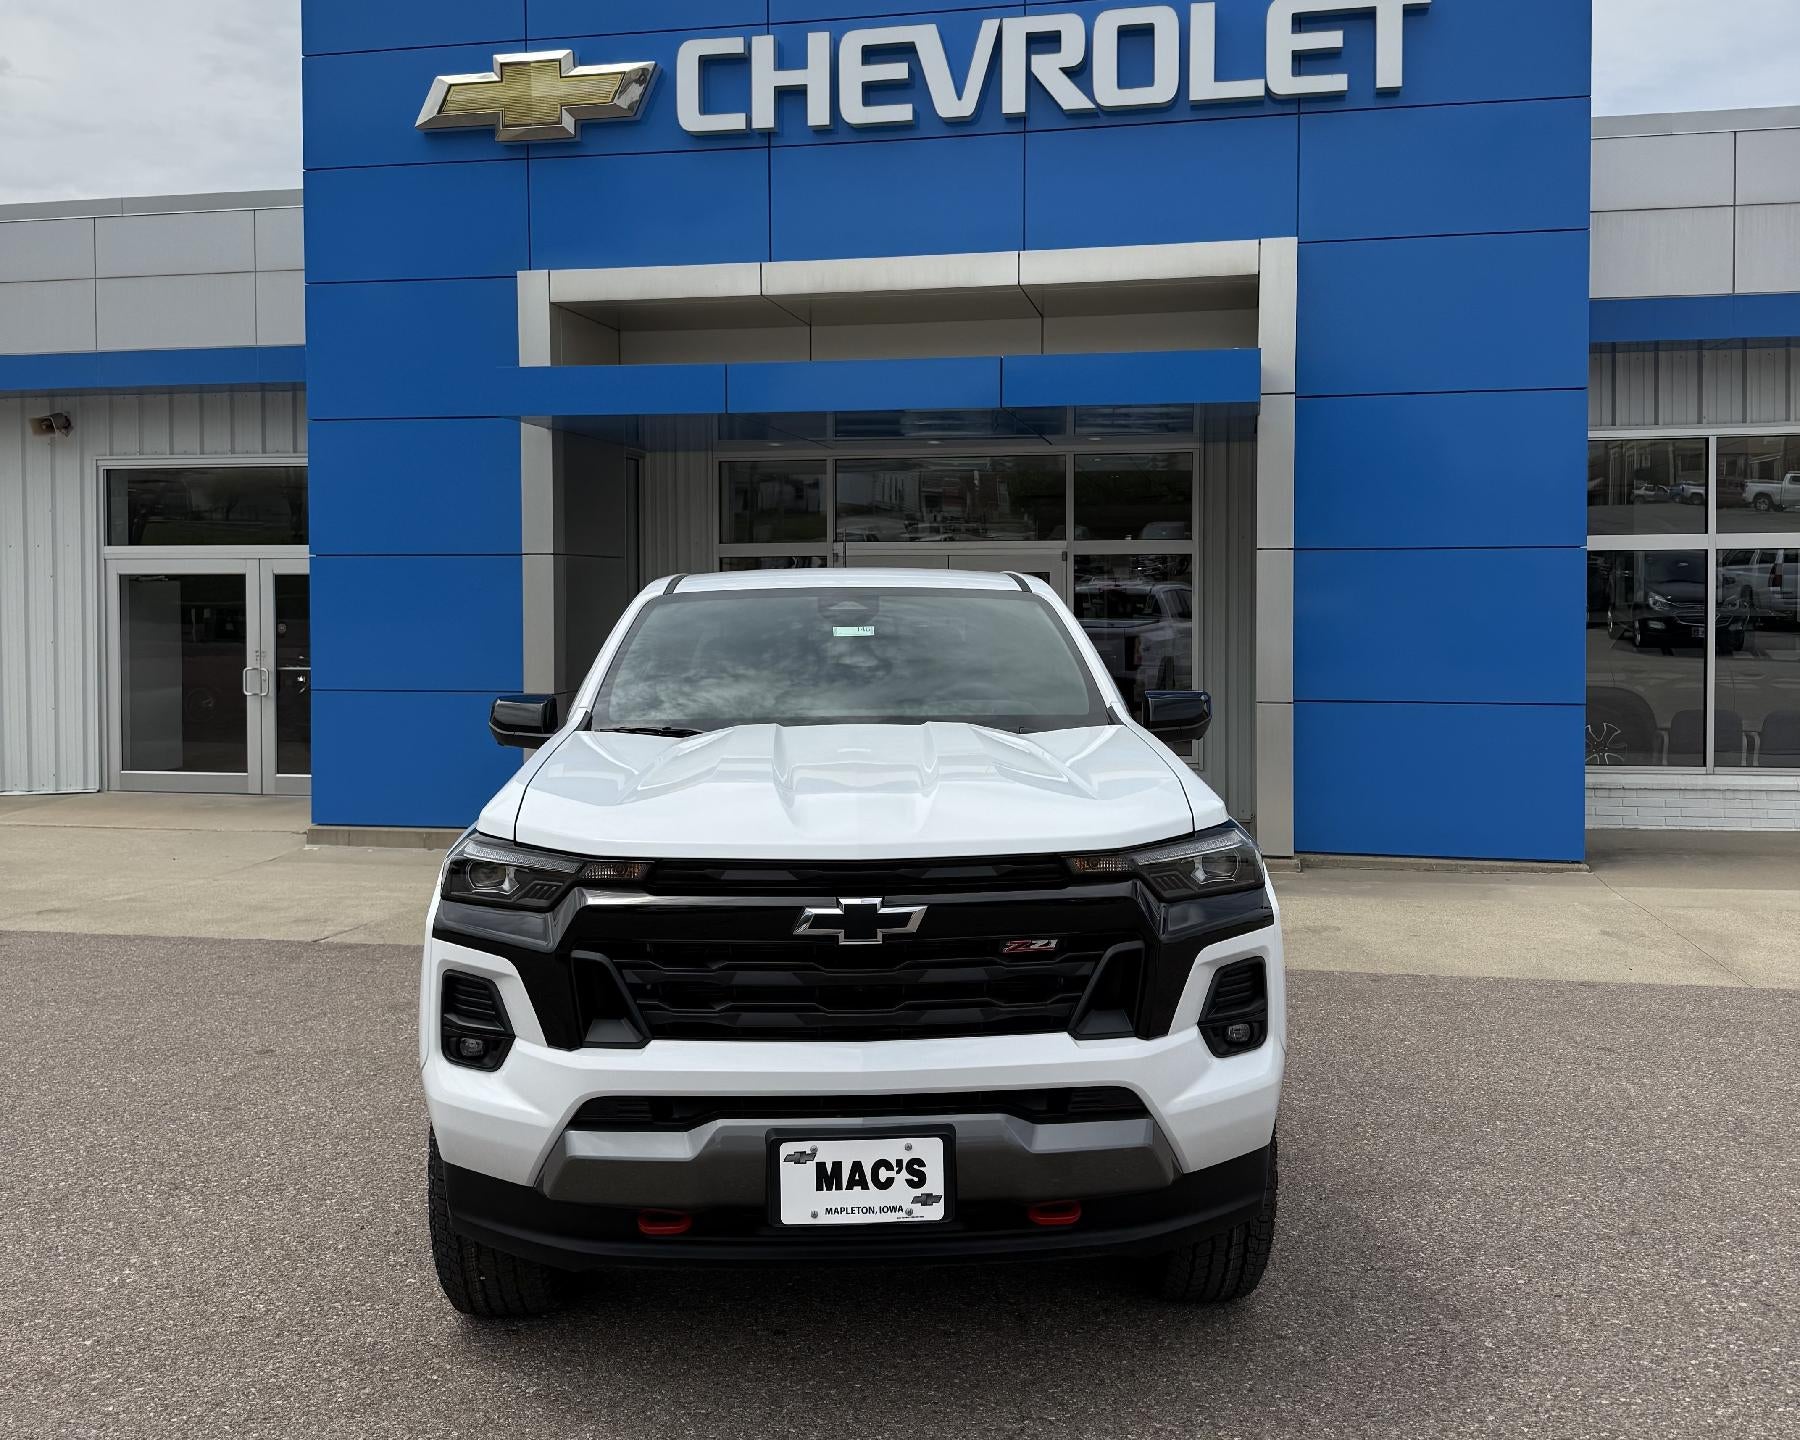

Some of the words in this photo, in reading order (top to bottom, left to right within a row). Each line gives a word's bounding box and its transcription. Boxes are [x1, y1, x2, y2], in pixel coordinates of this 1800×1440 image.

[676, 0, 1431, 135] CHEVROLET
[1003, 939, 1058, 953] Z71
[815, 1157, 927, 1192] MAC'S
[824, 1205, 878, 1216] MAPLETON,
[879, 1205, 904, 1215] IOWA
